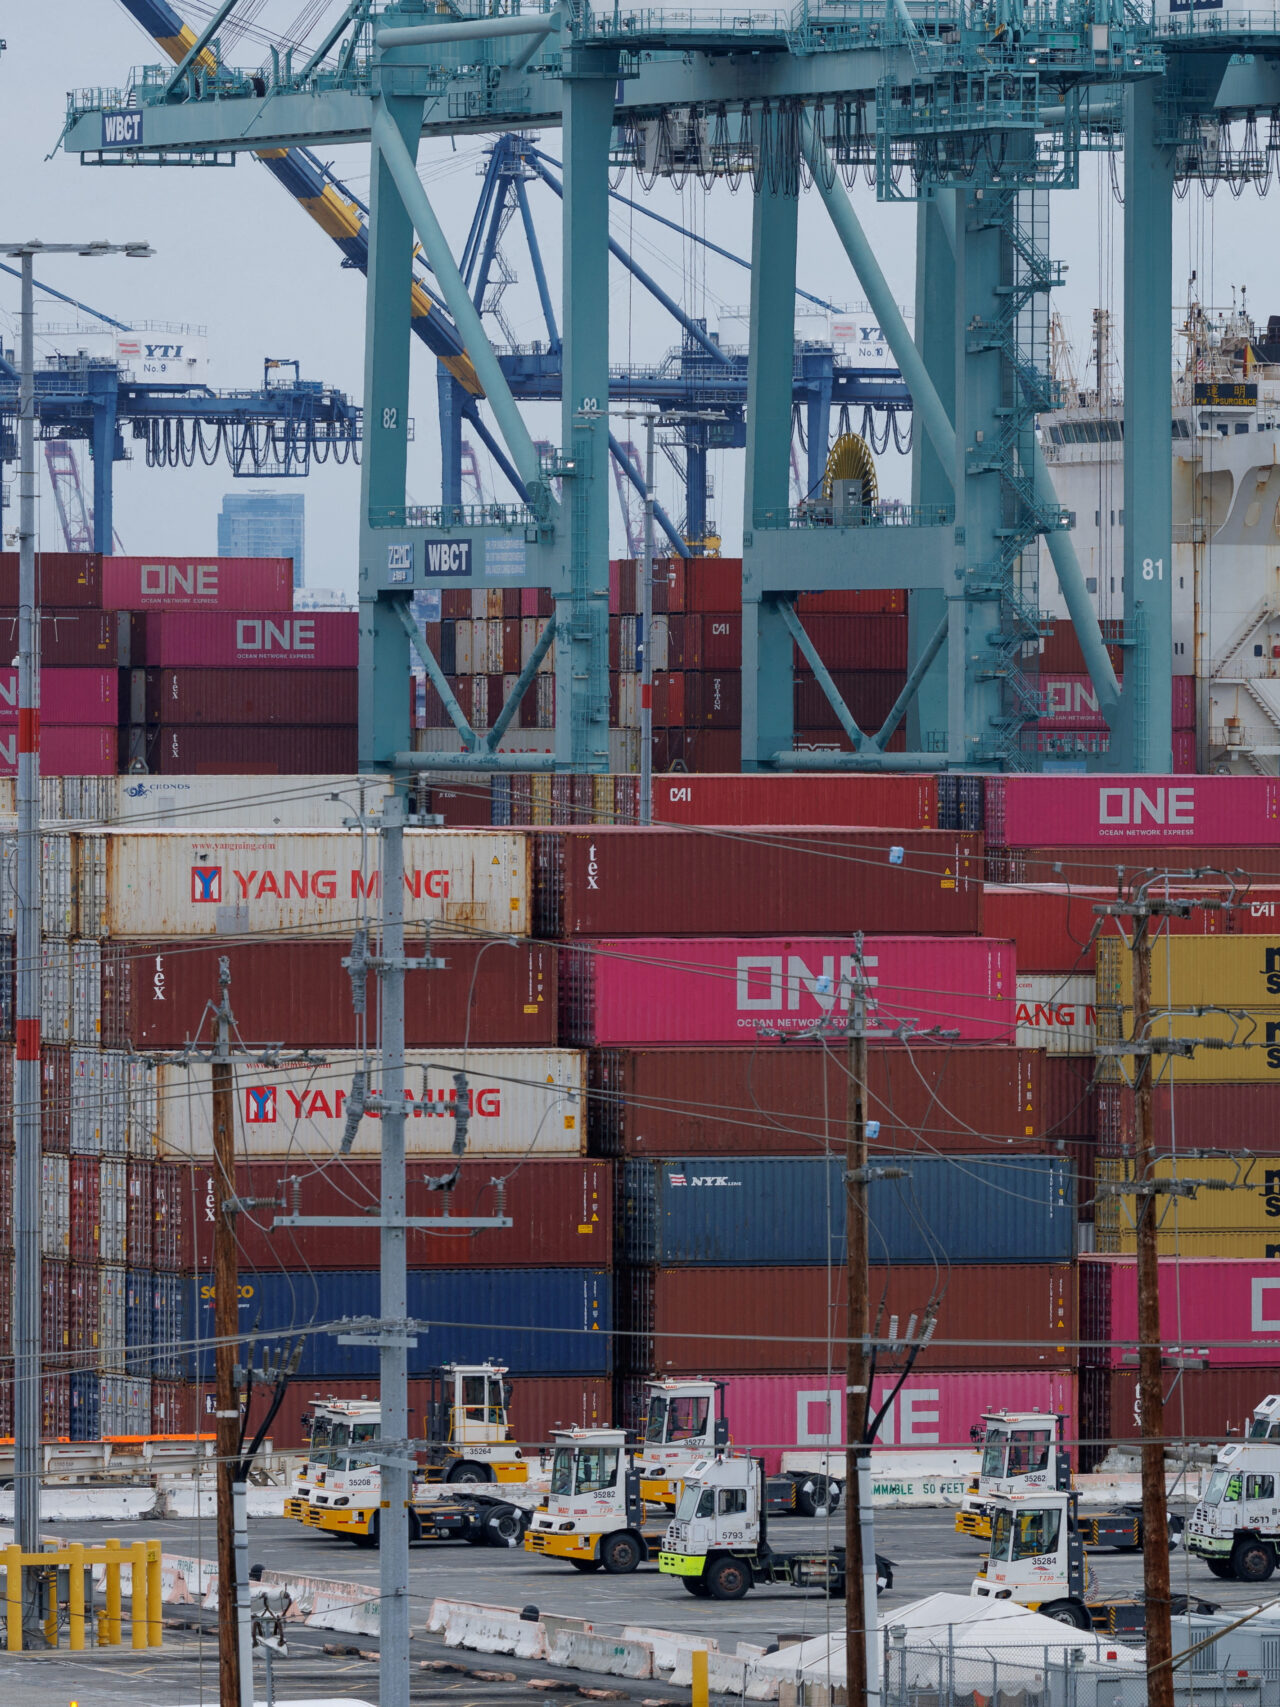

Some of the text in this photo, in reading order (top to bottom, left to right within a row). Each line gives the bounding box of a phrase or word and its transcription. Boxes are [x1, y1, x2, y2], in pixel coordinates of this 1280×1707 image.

[105, 114, 141, 142] WBCT
[859, 327, 885, 341] YT
[144, 345, 184, 357] YTI
[160, 363, 166, 373] 9
[383, 408, 396, 430] 82
[428, 543, 469, 571] WBCT
[1142, 558, 1163, 581] 81
[141, 565, 218, 595] ONE
[236, 619, 315, 650] ONE
[712, 623, 729, 635] CAI
[713, 678, 721, 711] TRITON
[1047, 682, 1099, 711] ON
[171, 732, 179, 758] tex
[670, 788, 692, 801] CAI
[1100, 787, 1194, 824] ONE
[191, 841, 276, 851] www.yangming.com
[587, 843, 598, 889] tex
[233, 869, 337, 899] YANG
[351, 869, 450, 899] MNG
[1251, 902, 1275, 917] CAI
[152, 955, 166, 1000] tex
[736, 956, 879, 1010] ONE
[737, 1018, 826, 1027] OCEAN NETWOR
[1016, 1003, 1075, 1026] ANG
[691, 1176, 728, 1186] NYK
[205, 1177, 216, 1222] tex
[469, 1447, 492, 1455] 35264
[349, 1479, 371, 1487] 35208
[1024, 1474, 1046, 1482] 35262
[593, 1490, 616, 1499] 35282
[922, 1483, 936, 1494] 50
[940, 1482, 965, 1494] FEET
[722, 1531, 743, 1540] 5793
[1032, 1557, 1057, 1565] 35284
